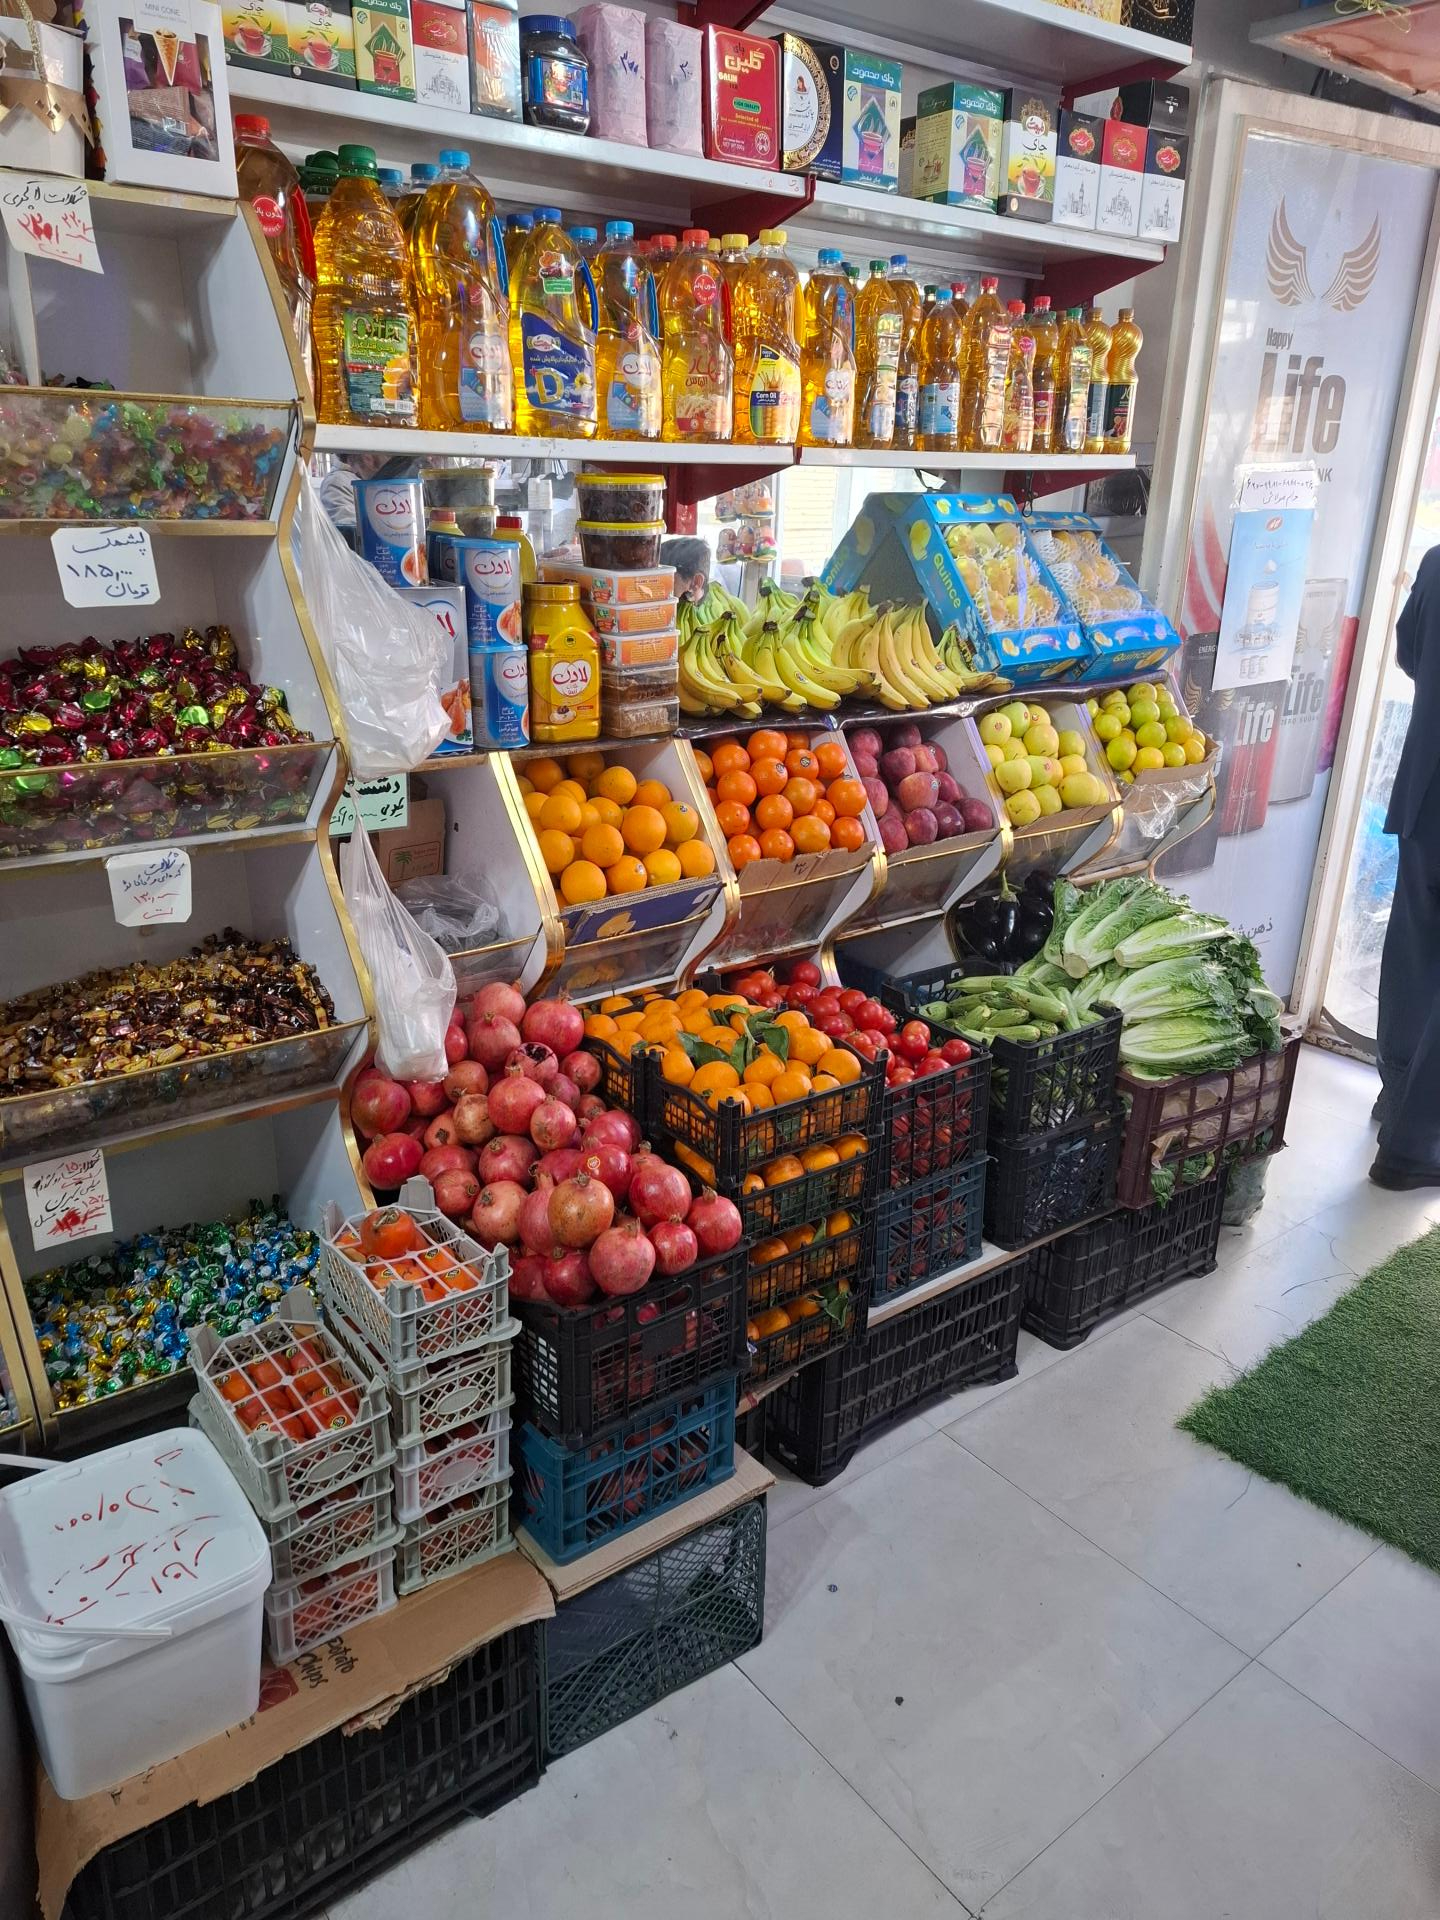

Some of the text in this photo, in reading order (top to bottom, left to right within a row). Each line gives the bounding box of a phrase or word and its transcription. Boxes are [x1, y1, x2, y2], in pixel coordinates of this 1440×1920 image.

[1266, 327, 1294, 350] Happy
[1256, 351, 1347, 454] Life
[72, 527, 147, 556] پشمک
[474, 560, 512, 576] لادن
[933, 552, 961, 609] Quince
[104, 582, 151, 600] تومان
[552, 666, 588, 685] لادن
[1233, 693, 1276, 747] Life
[294, 1651, 329, 1689] Chips
[326, 1636, 359, 1674] Potato
